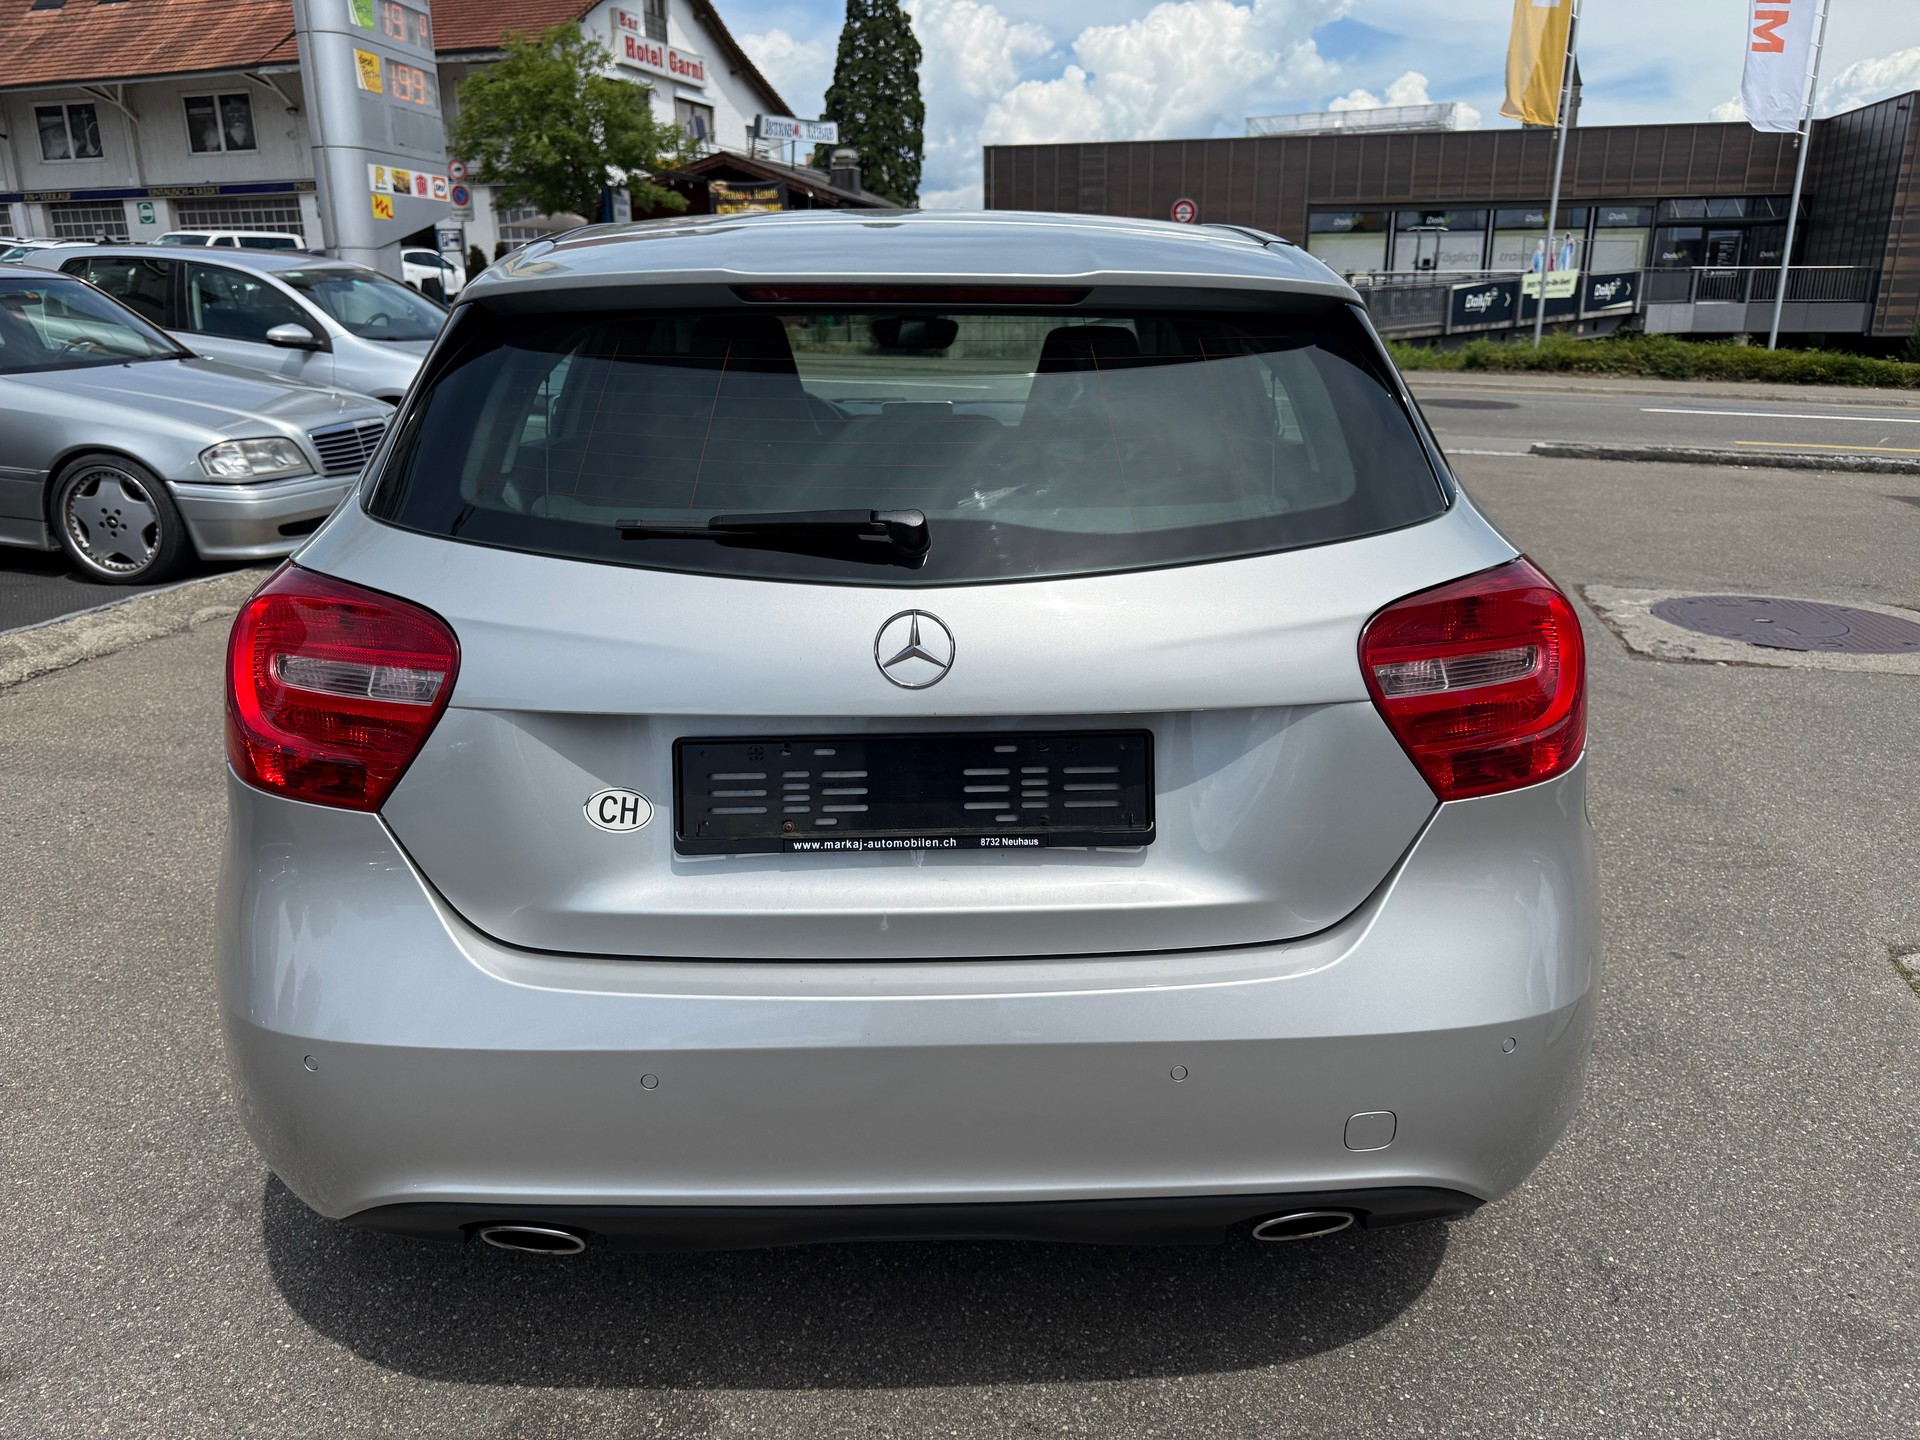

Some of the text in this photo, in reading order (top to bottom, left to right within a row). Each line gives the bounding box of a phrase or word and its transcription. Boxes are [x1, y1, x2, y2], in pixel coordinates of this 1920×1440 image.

[619, 10, 639, 31] Bar
[625, 35, 705, 81] Hotel Garni
[599, 795, 639, 825] CH
[793, 836, 1039, 851] www.markaj-automobilen.ch 8732 Neuhaus
